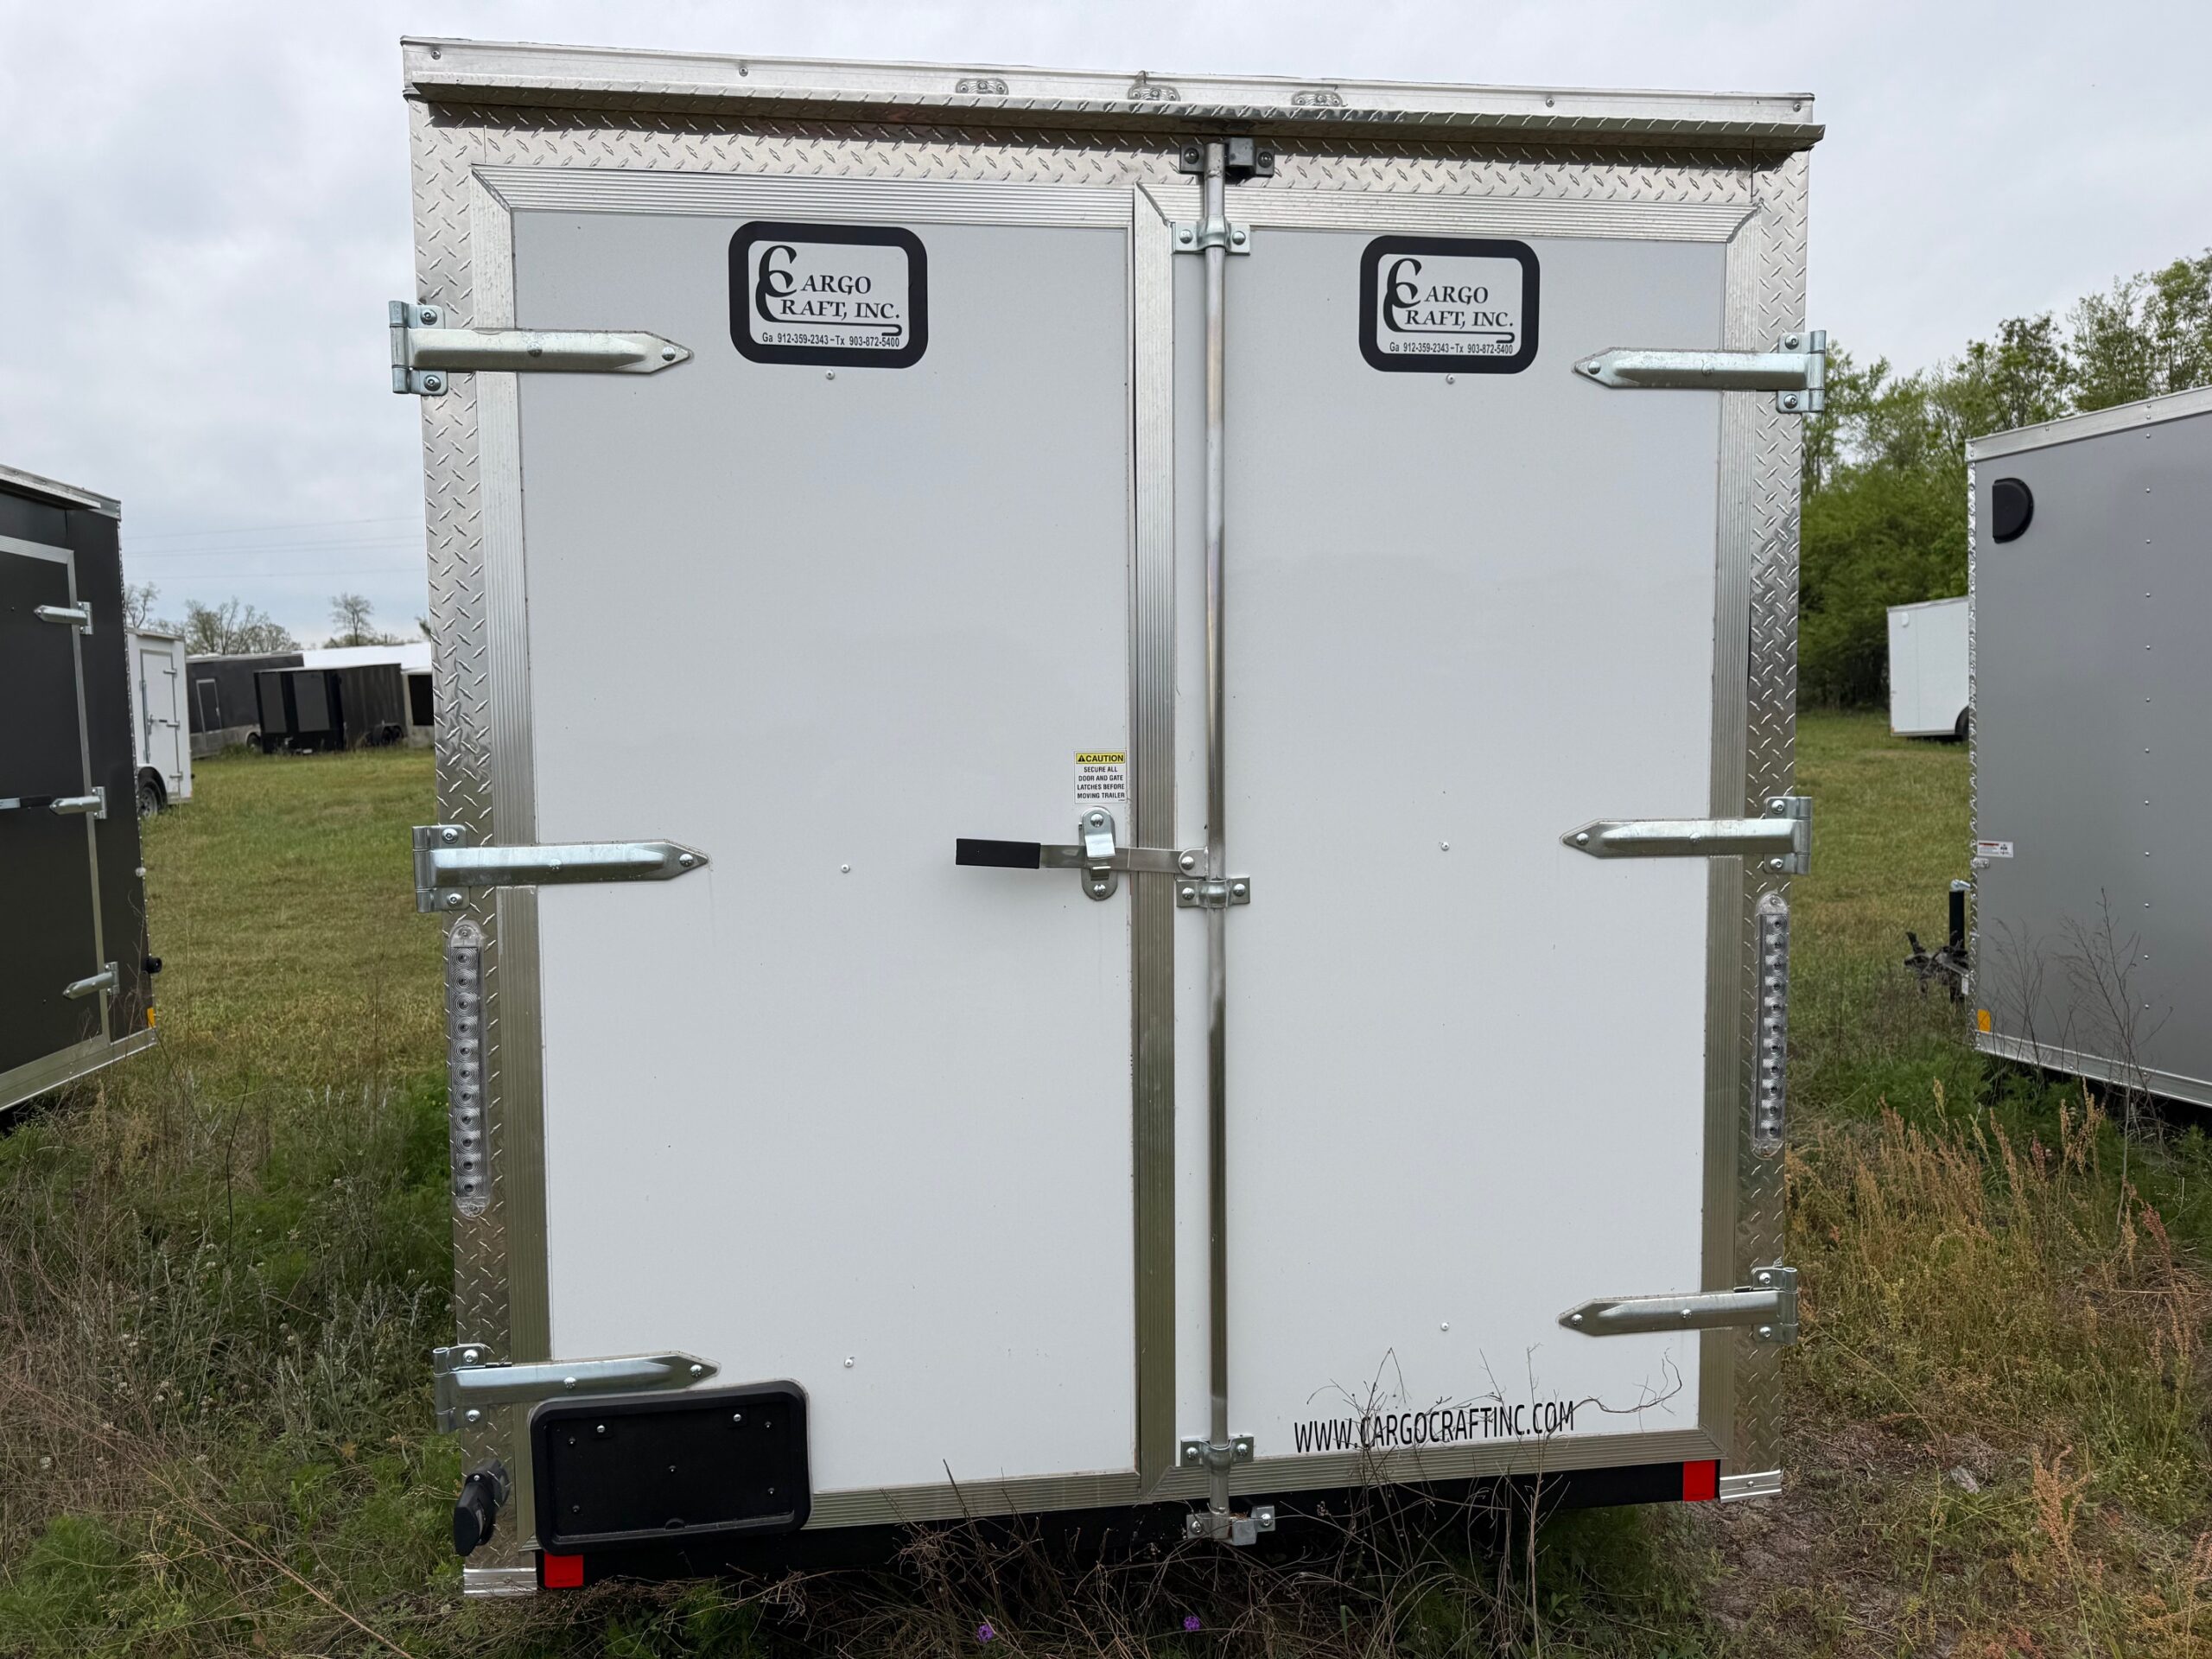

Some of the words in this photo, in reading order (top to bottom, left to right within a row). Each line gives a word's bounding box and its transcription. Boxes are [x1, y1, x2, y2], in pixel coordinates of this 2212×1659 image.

[854, 302, 900, 320] INC.
[1471, 311, 1514, 327] INC.
[762, 332, 773, 343] Ga
[849, 335, 899, 347] 903-872-5400
[1389, 341, 1400, 352] Ga
[1467, 344, 1513, 355] 903-872-5400
[1294, 1400, 1574, 1453] WWW.CARGOCRAFTINC.COM
